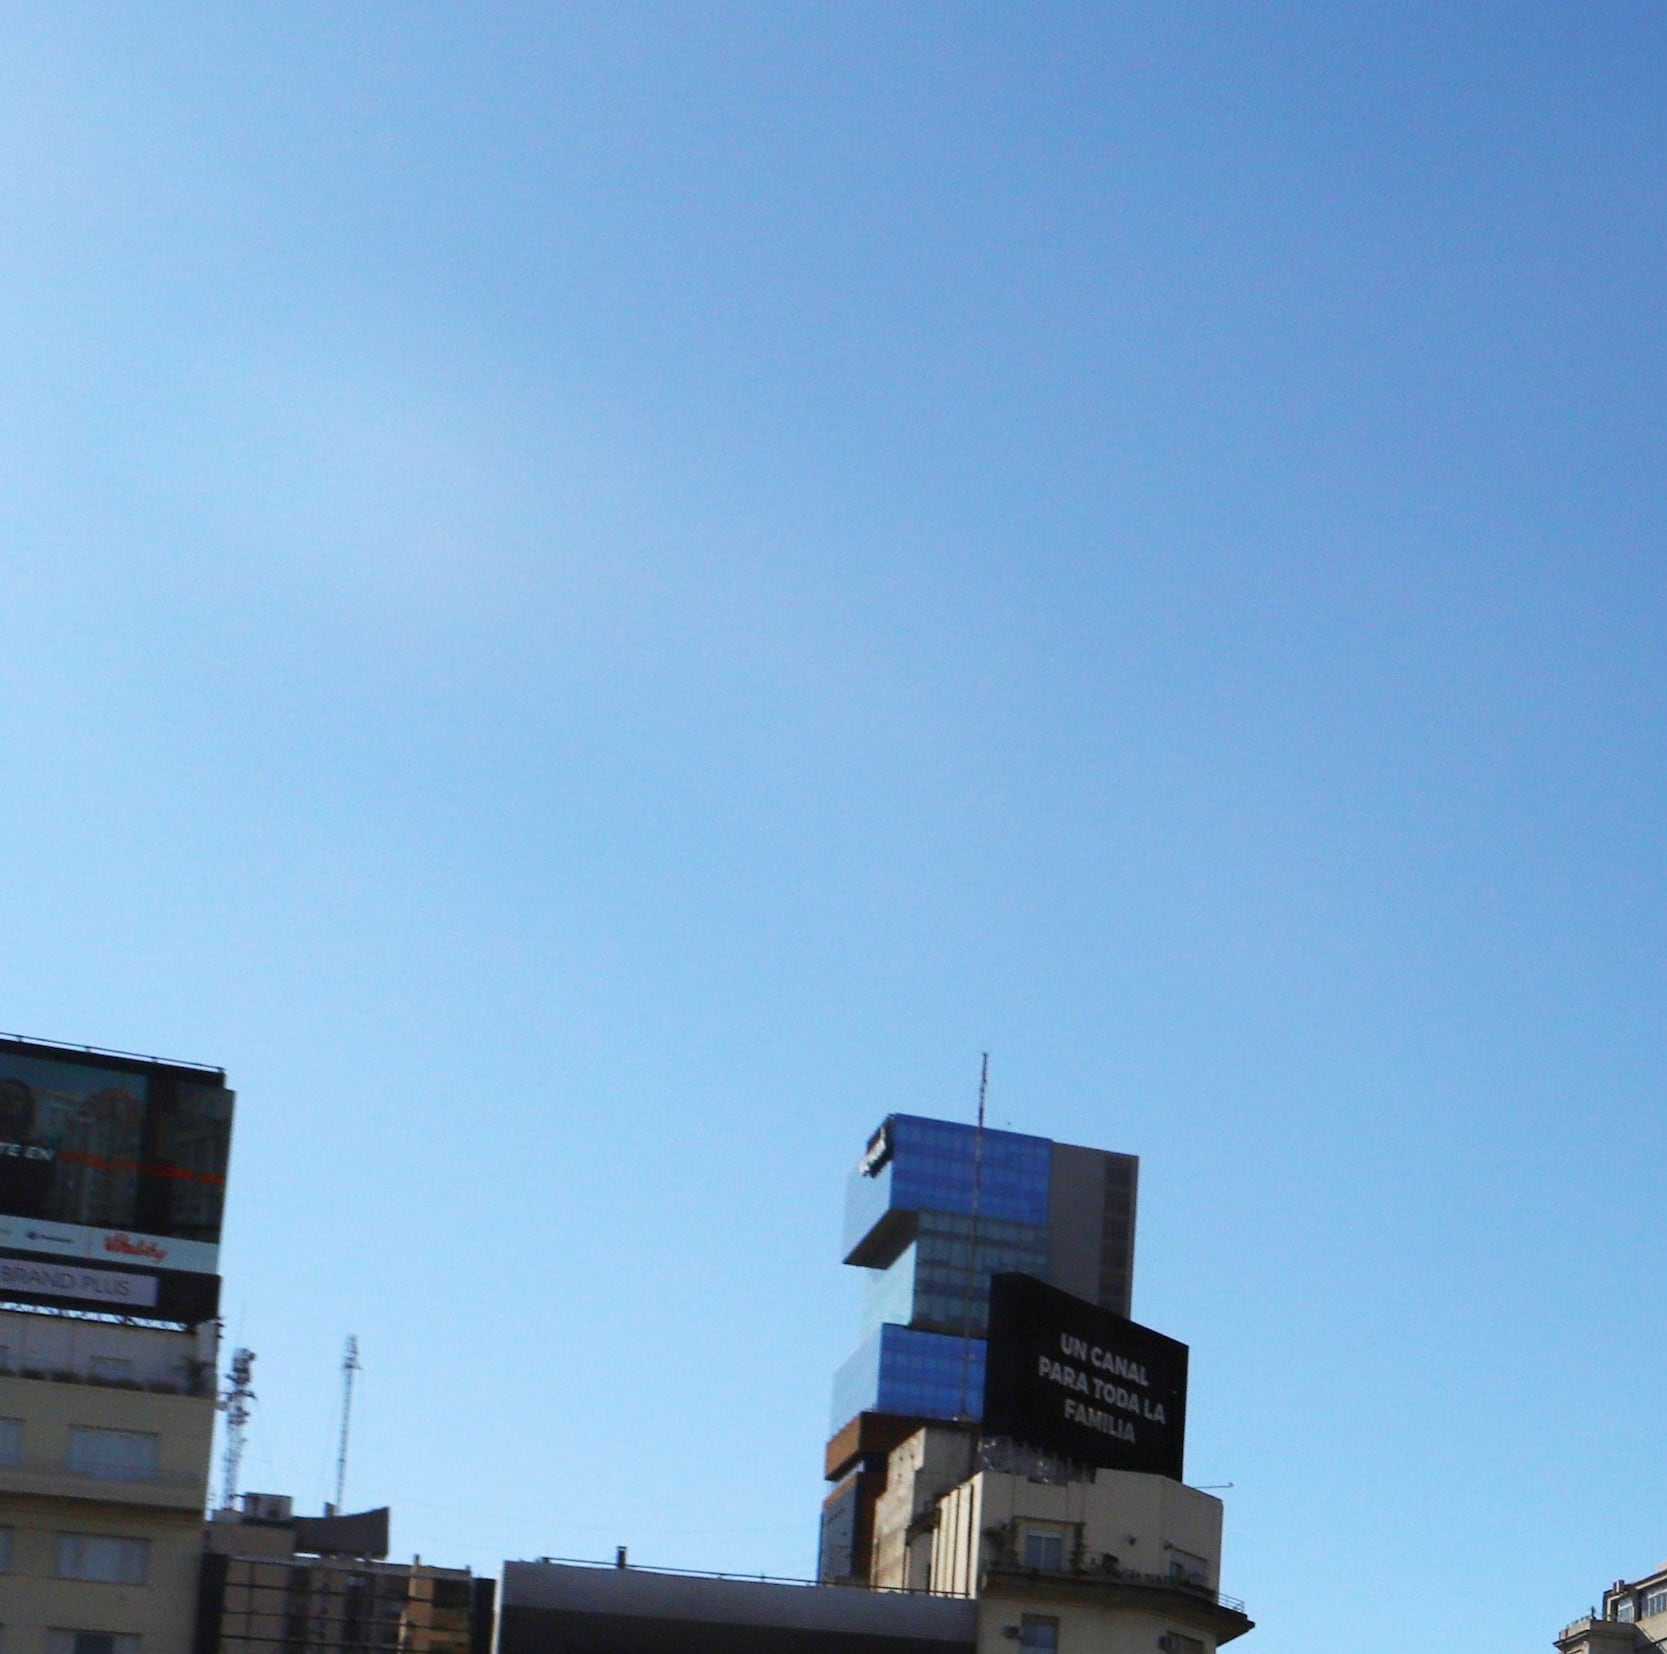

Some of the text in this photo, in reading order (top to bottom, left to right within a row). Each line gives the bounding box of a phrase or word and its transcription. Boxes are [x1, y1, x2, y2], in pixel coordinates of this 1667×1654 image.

[80, 1275, 131, 1298] PLUS
[1061, 1333, 1149, 1387] UN CANAL
[1039, 1355, 1165, 1425] PARA TODA LA
[1064, 1398, 1136, 1443] FAMILIA
